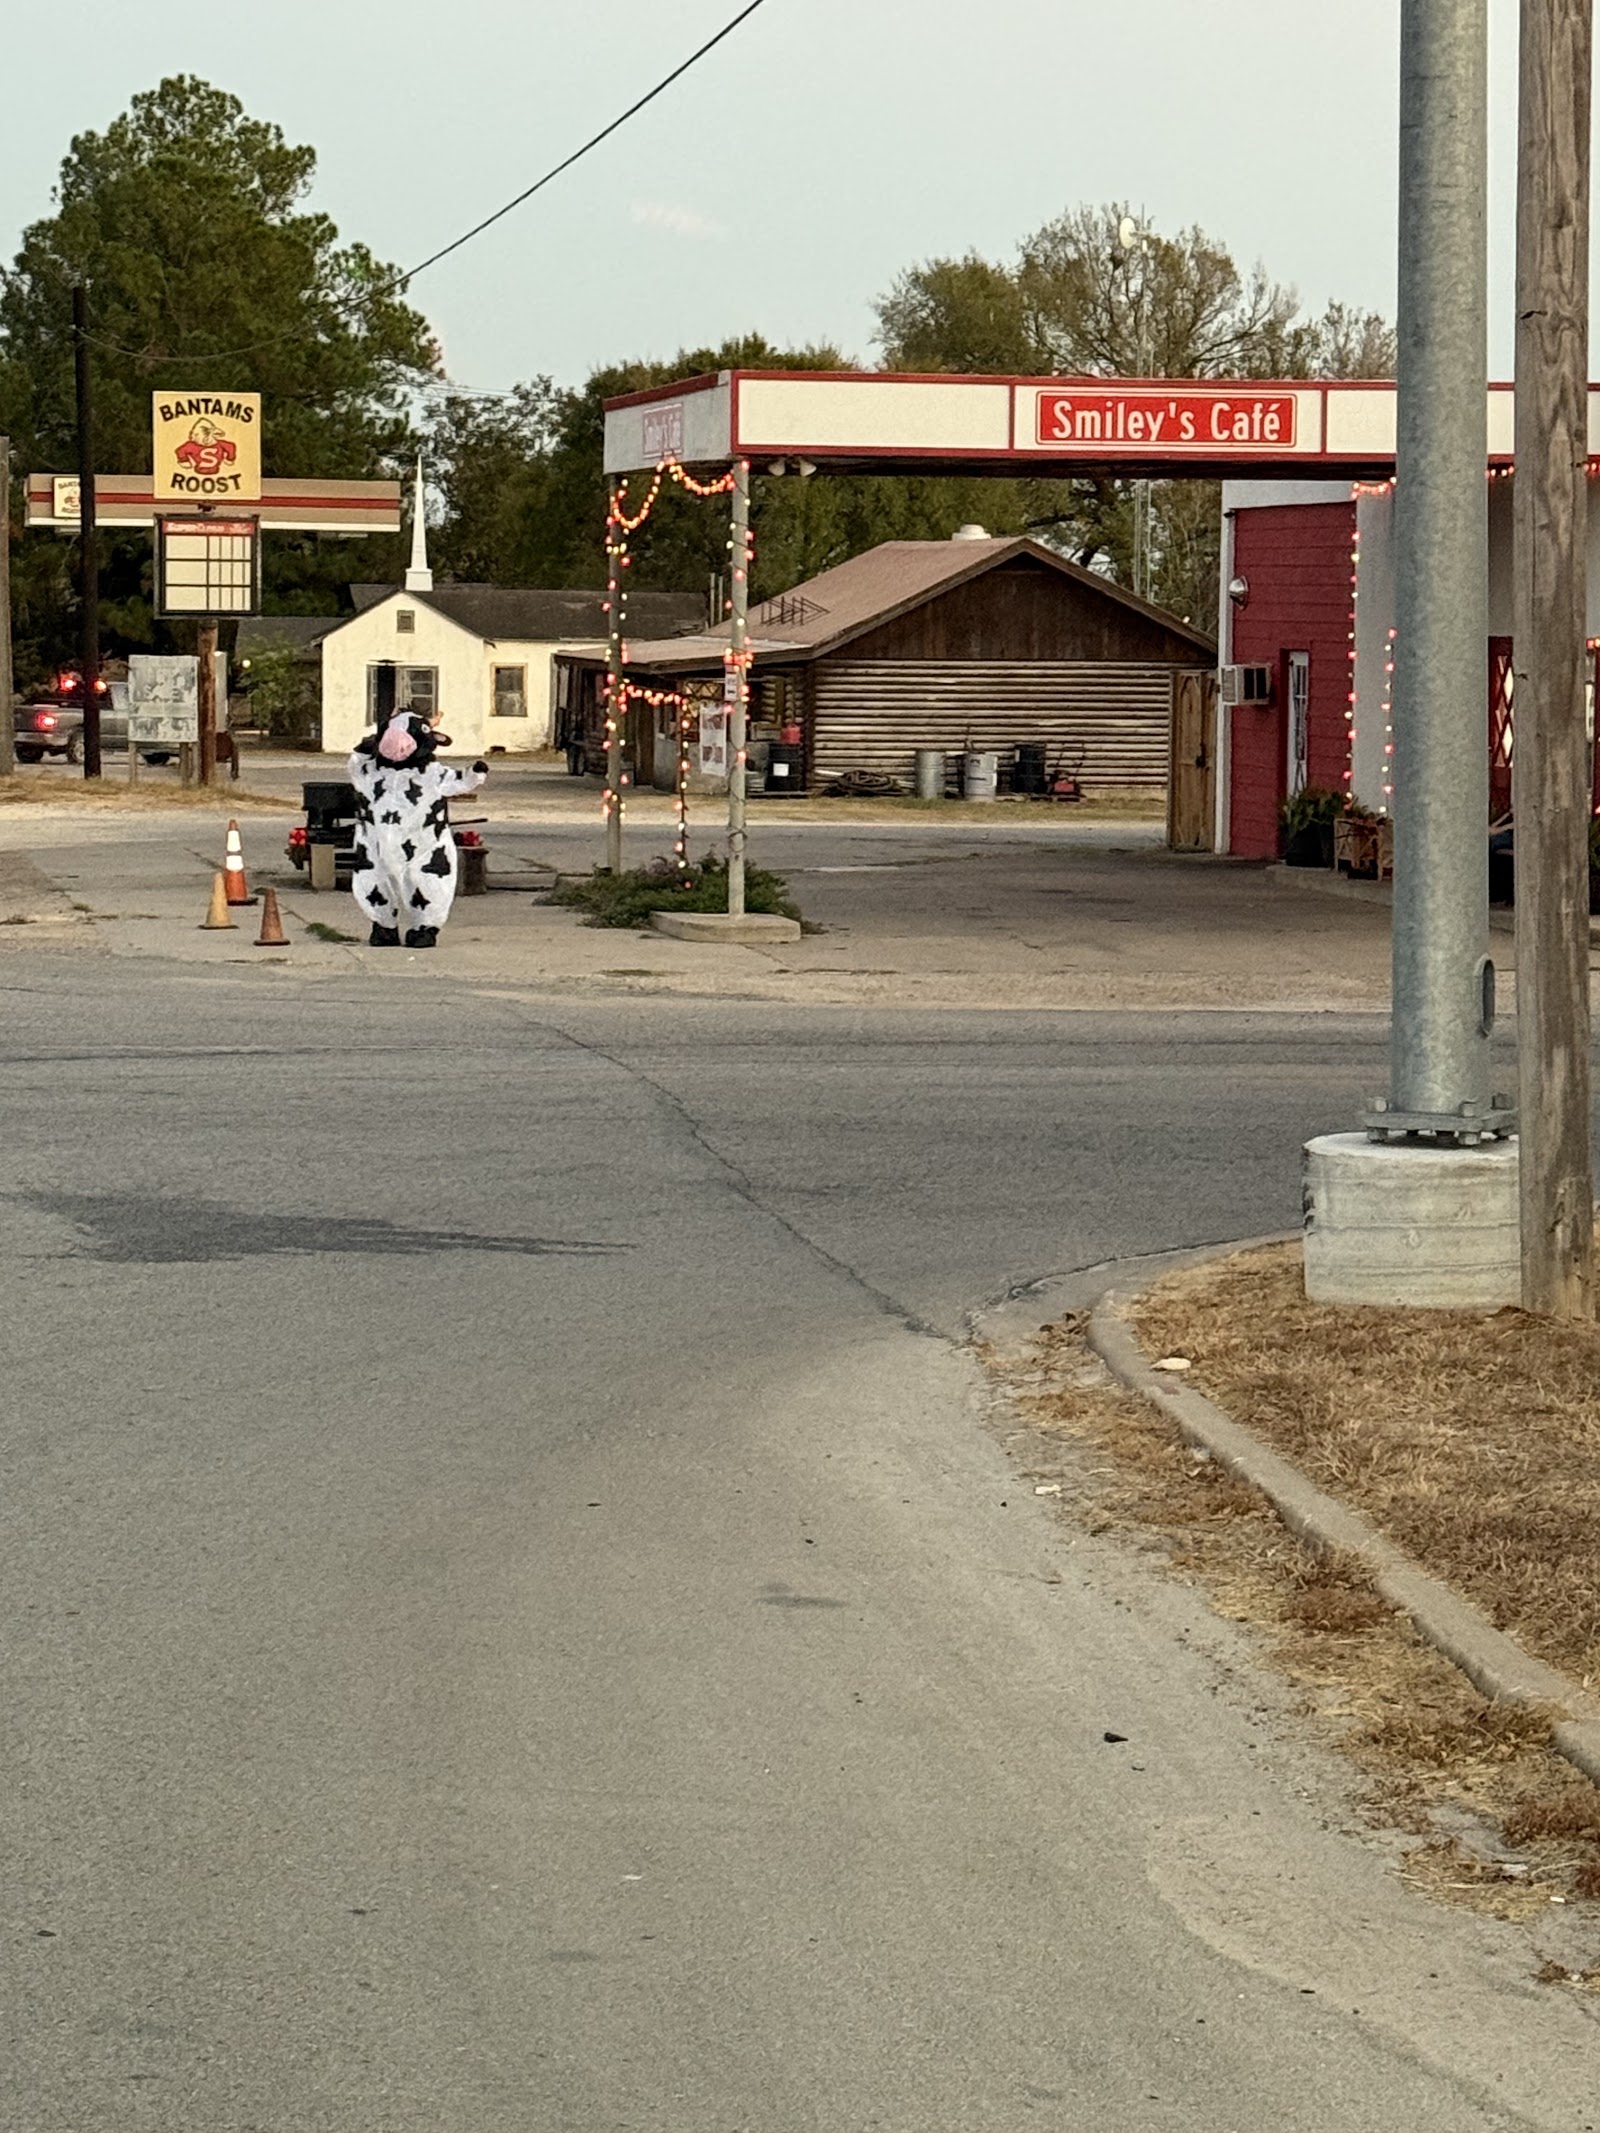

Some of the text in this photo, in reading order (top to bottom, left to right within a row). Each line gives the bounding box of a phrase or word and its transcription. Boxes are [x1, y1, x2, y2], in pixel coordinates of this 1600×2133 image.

[159, 398, 254, 423] BANTAMS
[1052, 399, 1281, 441] Smiley's Café
[199, 447, 219, 468] S
[170, 472, 242, 494] ROOST
